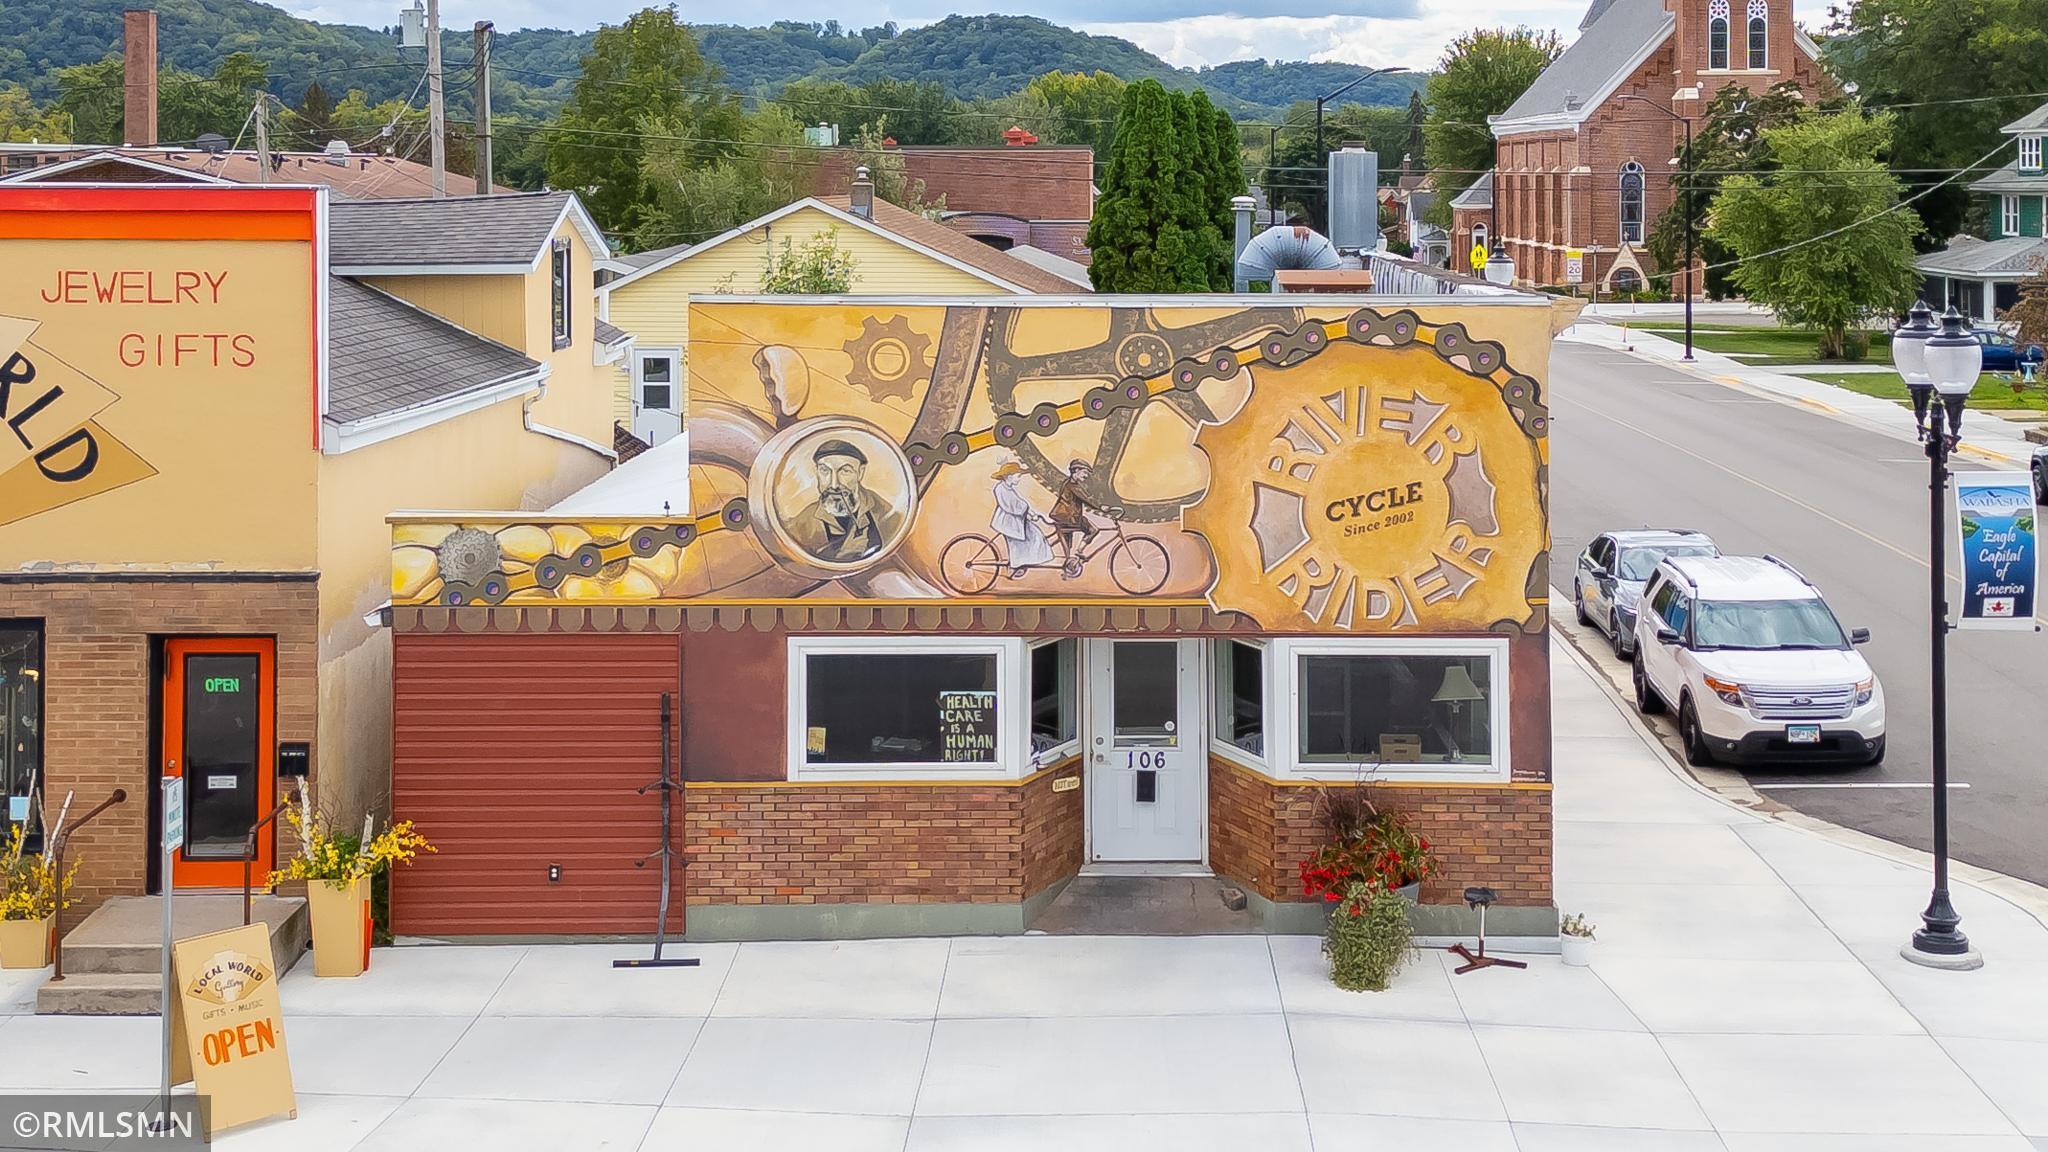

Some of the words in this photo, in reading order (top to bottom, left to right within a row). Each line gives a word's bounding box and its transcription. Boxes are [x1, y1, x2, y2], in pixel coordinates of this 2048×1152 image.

[1568, 266, 1581, 274] 20
[40, 270, 228, 304] JEWELRY
[119, 333, 256, 367] GIFTS
[1258, 384, 1482, 486] RIVER
[1325, 481, 1423, 522] CYCLE
[1962, 497, 2030, 507] WABASHA
[1343, 521, 1380, 537] Since
[1384, 510, 1414, 528] 2002
[1982, 526, 2016, 550] Eagle
[1979, 545, 2024, 569] Capital
[1268, 530, 1496, 631] RIDER
[1995, 562, 2010, 581] of
[1975, 582, 2024, 595] America
[205, 678, 239, 692] OPEN
[946, 694, 993, 709] HEALTH
[945, 710, 983, 723] CARE
[950, 723, 960, 734] IS
[966, 723, 975, 734] A
[946, 734, 993, 749] HUMAN
[944, 749, 984, 762] RIGHT!
[1127, 750, 1166, 769] 106
[193, 965, 224, 994] LOCAL
[228, 961, 264, 981] WORLD
[203, 1007, 226, 1020] GIFTS
[238, 999, 264, 1012] MUSIC
[203, 1017, 275, 1067] OPEN
